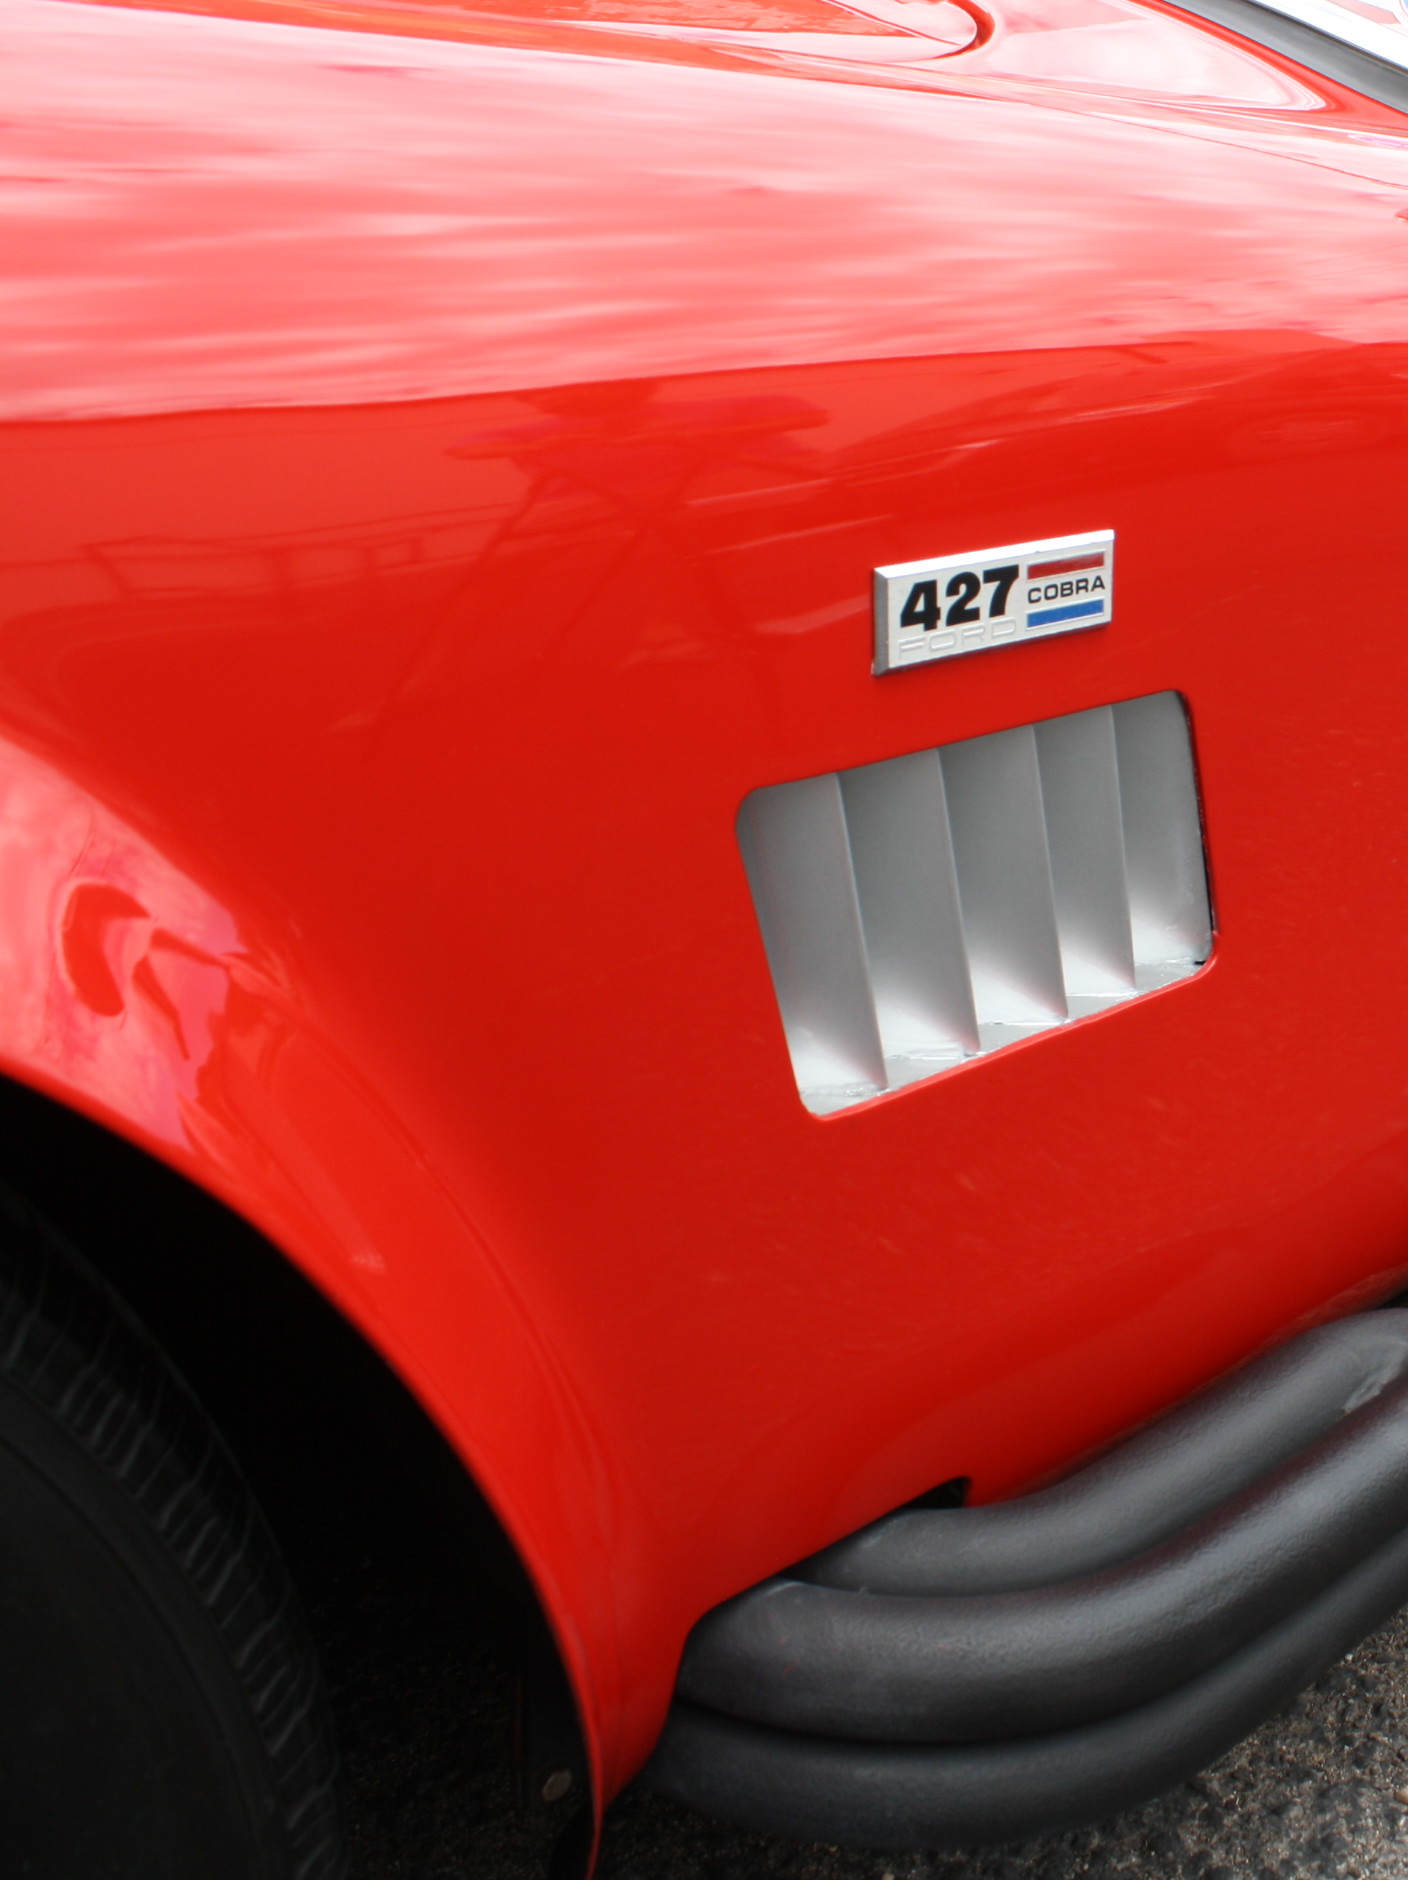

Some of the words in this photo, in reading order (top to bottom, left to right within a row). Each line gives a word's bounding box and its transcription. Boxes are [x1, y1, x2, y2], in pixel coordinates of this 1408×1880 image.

[900, 564, 1020, 631] 427
[1027, 575, 1106, 605] COBRA
[898, 616, 1018, 660] FORD
